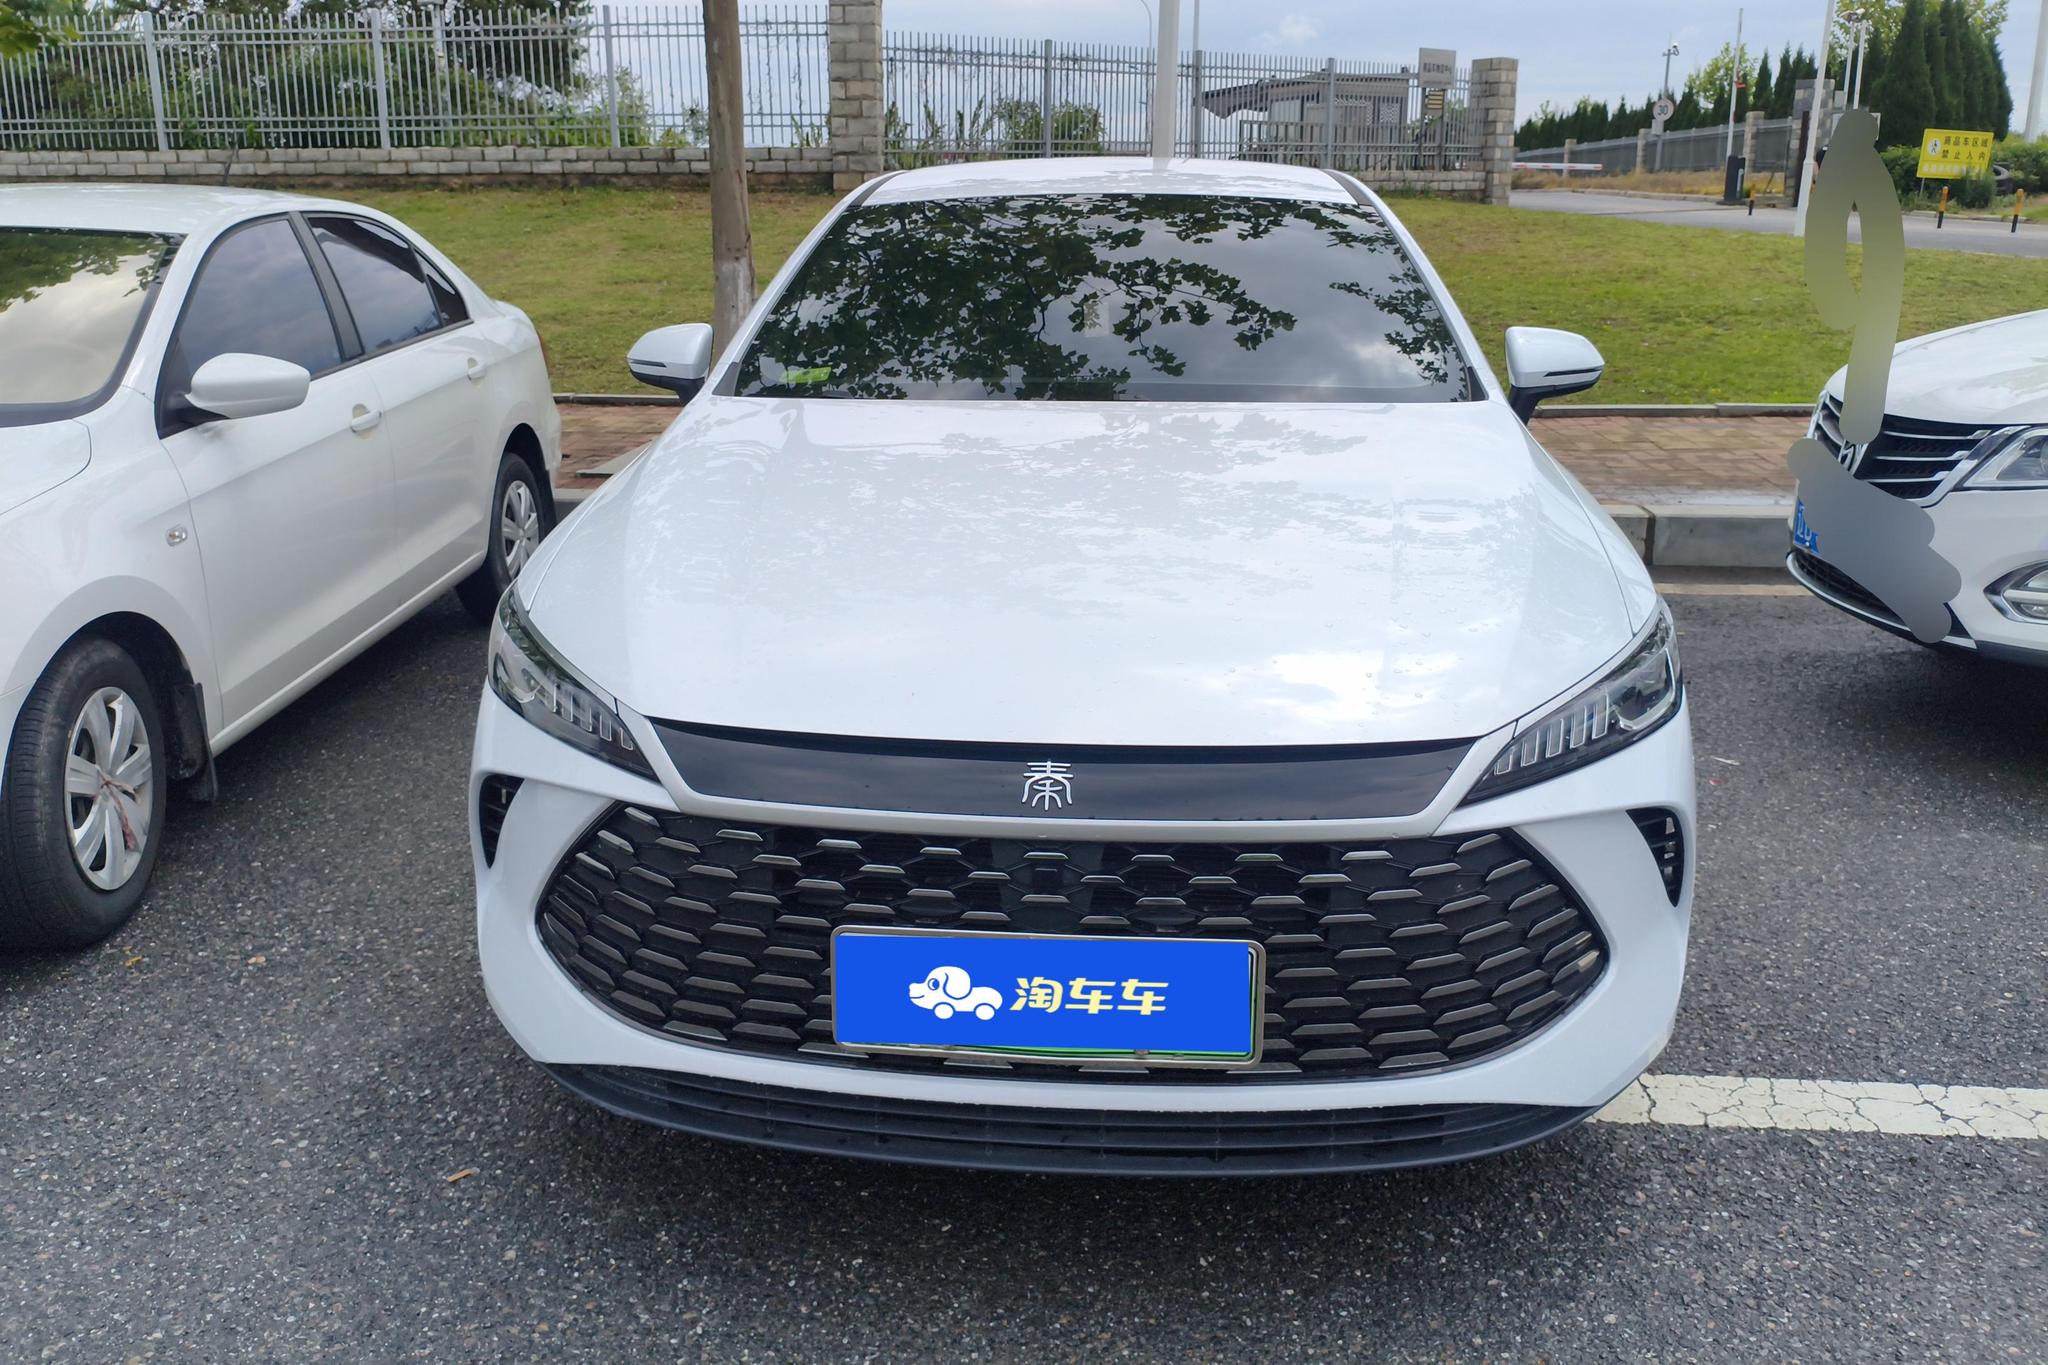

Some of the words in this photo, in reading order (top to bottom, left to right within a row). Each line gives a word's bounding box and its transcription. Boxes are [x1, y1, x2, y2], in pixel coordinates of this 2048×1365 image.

[1944, 136, 1989, 147] 商品车区域
[1942, 149, 1986, 160] 禁止入内
[1021, 760, 1074, 811] 秦
